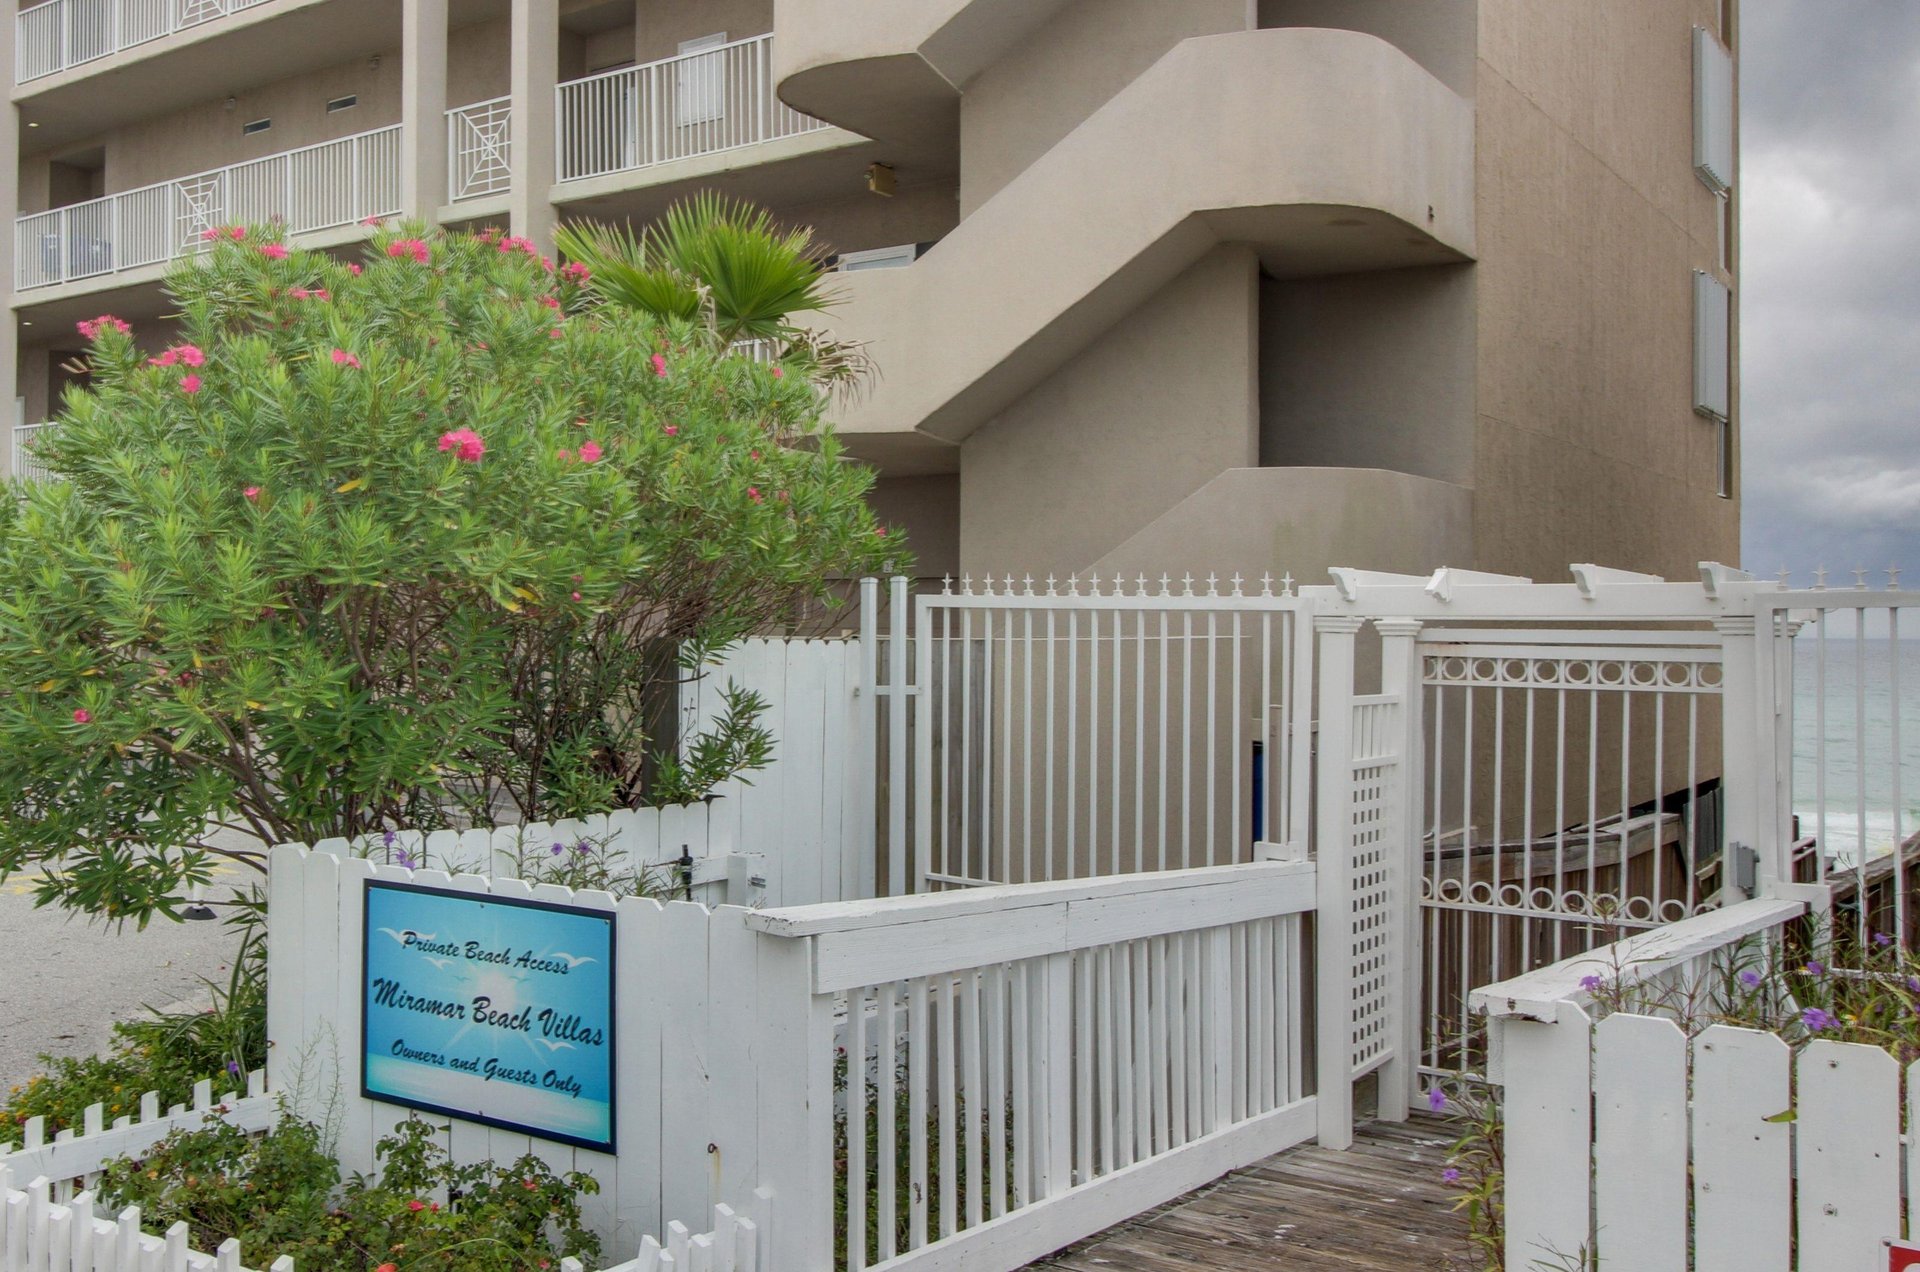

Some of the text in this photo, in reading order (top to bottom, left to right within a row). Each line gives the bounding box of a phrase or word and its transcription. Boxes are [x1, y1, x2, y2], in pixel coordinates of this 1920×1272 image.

[402, 930, 569, 975] Private Beach Access
[373, 978, 603, 1046] Miramar Beach Villas
[391, 1039, 582, 1098] Owners and Guests Only
